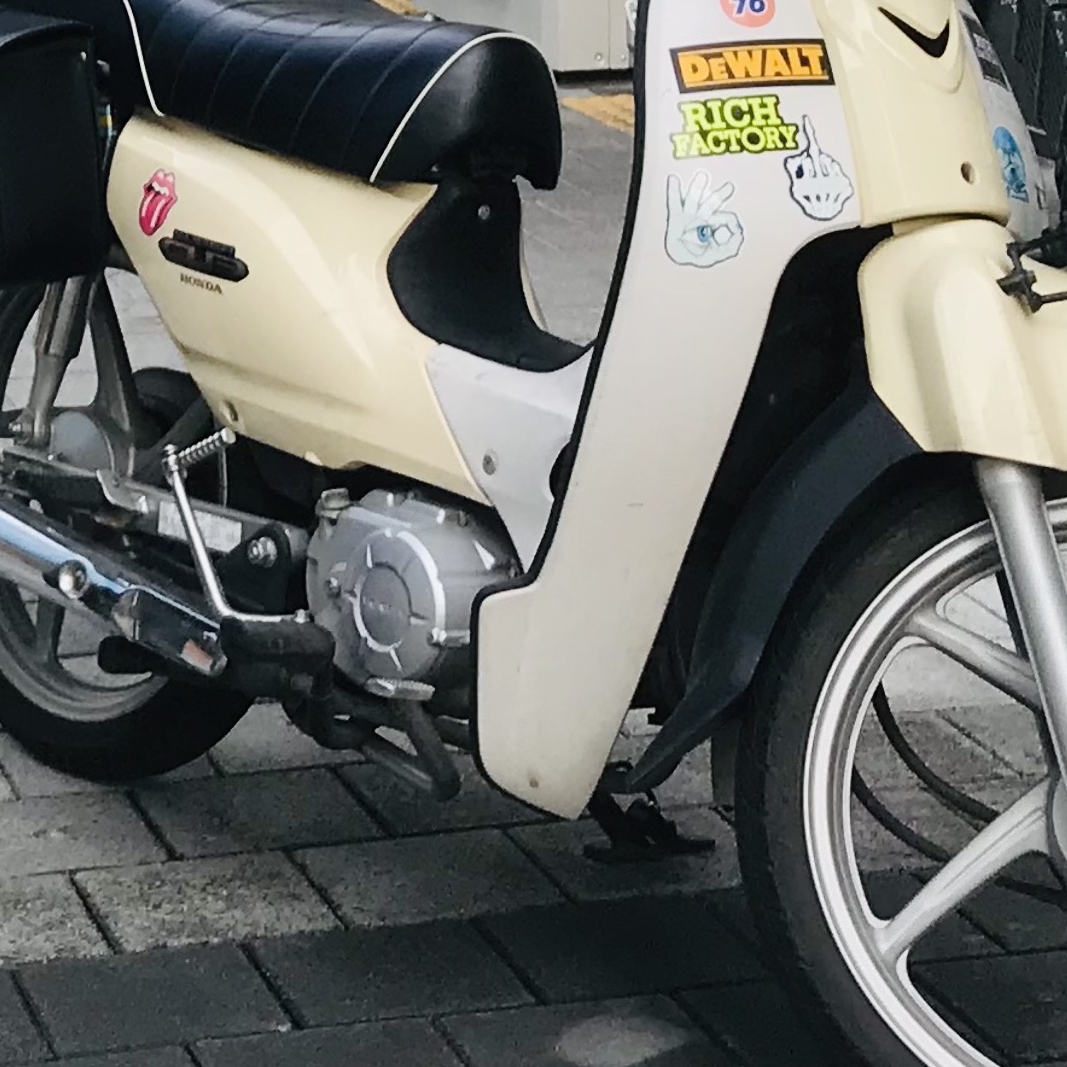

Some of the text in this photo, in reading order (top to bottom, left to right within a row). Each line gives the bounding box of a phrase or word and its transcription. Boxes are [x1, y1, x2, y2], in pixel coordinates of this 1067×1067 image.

[679, 95, 783, 133] RICH
[672, 124, 799, 159] FACTORY
[180, 273, 223, 294] HONDA
